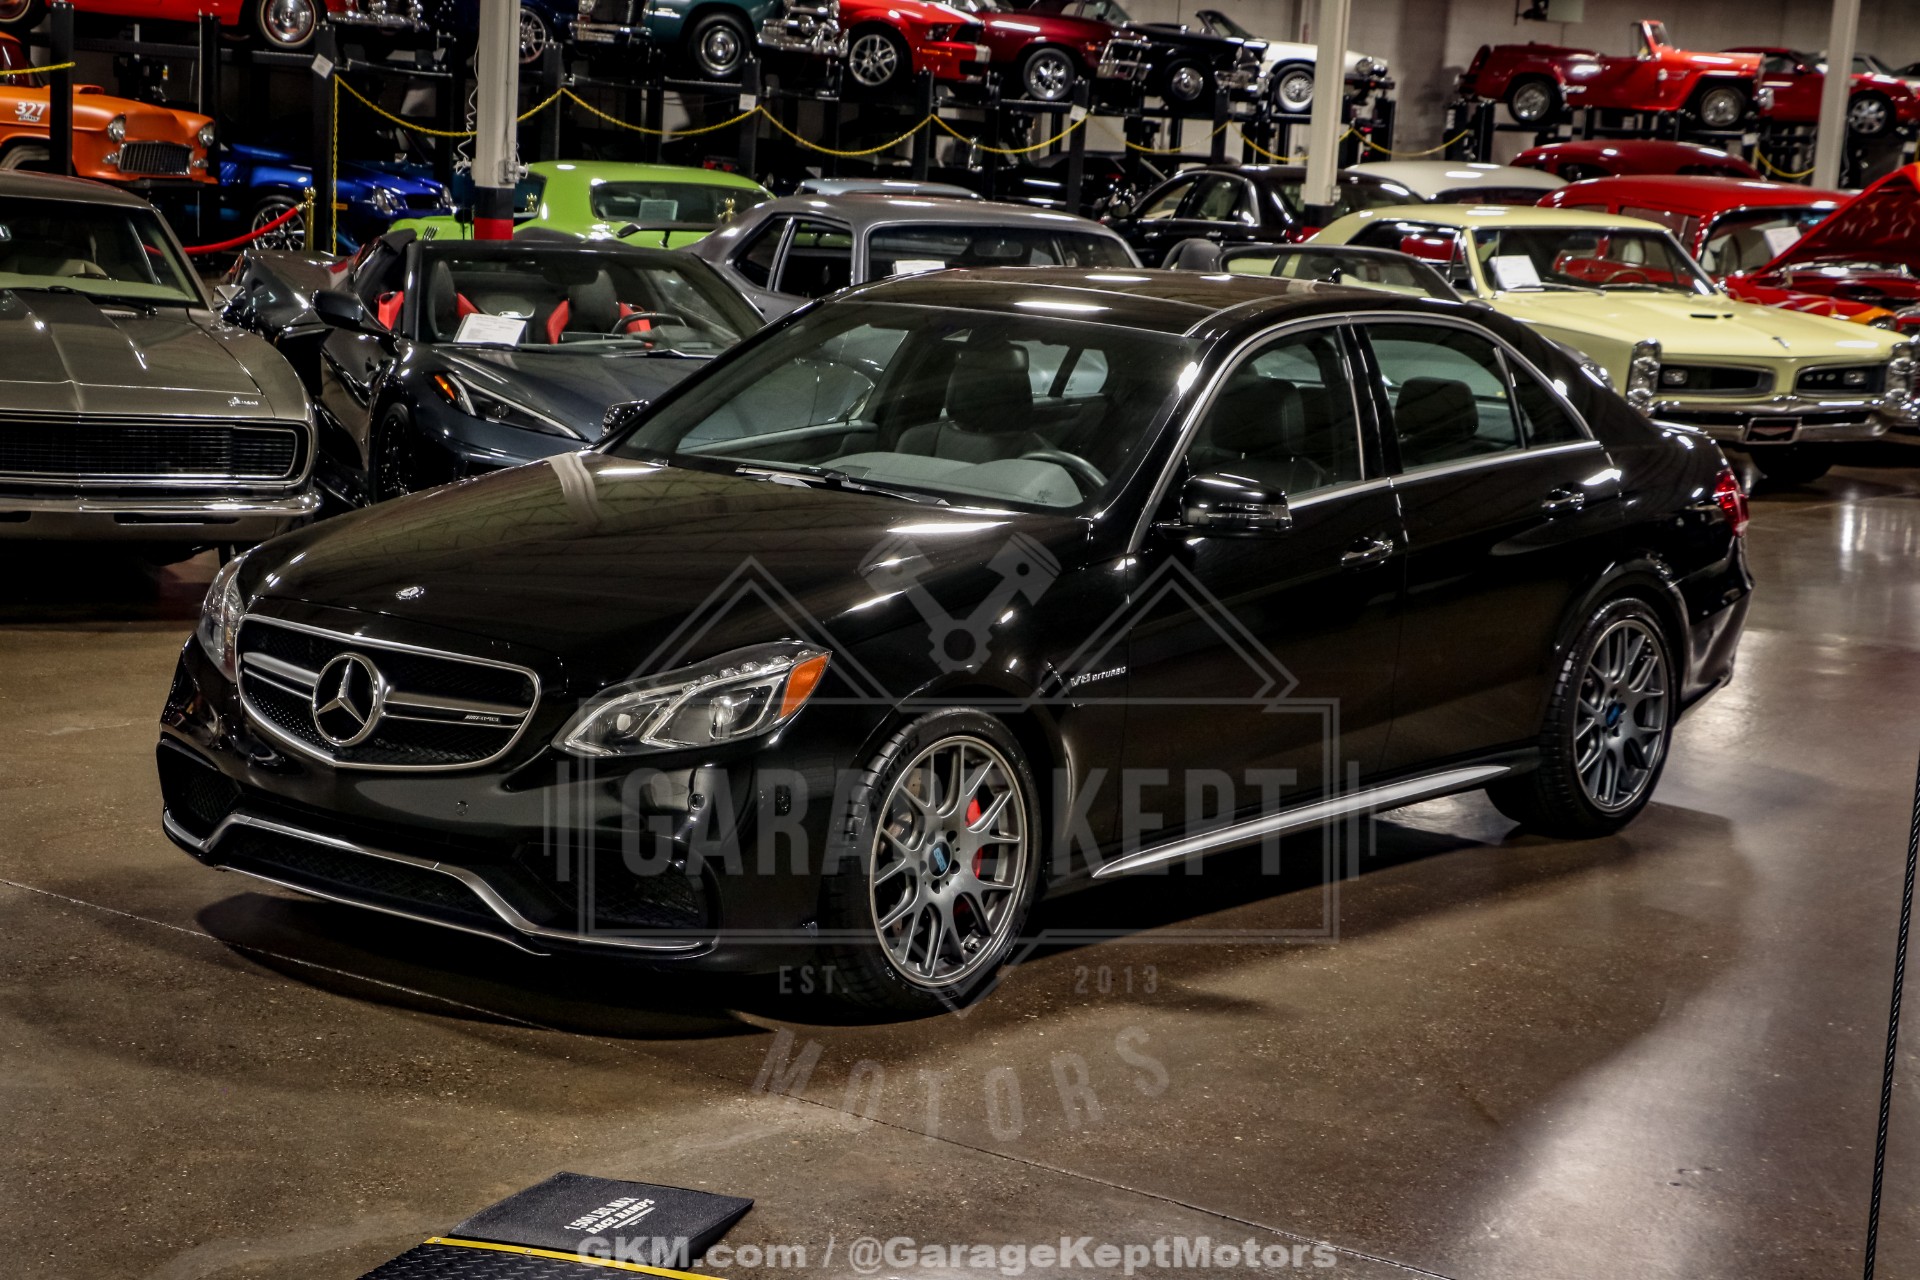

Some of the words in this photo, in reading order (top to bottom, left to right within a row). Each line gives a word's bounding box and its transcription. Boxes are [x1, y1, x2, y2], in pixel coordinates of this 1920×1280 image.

[14, 101, 46, 117] 327
[585, 1216, 620, 1234] RACE
[613, 1198, 655, 1219] RAMPS
